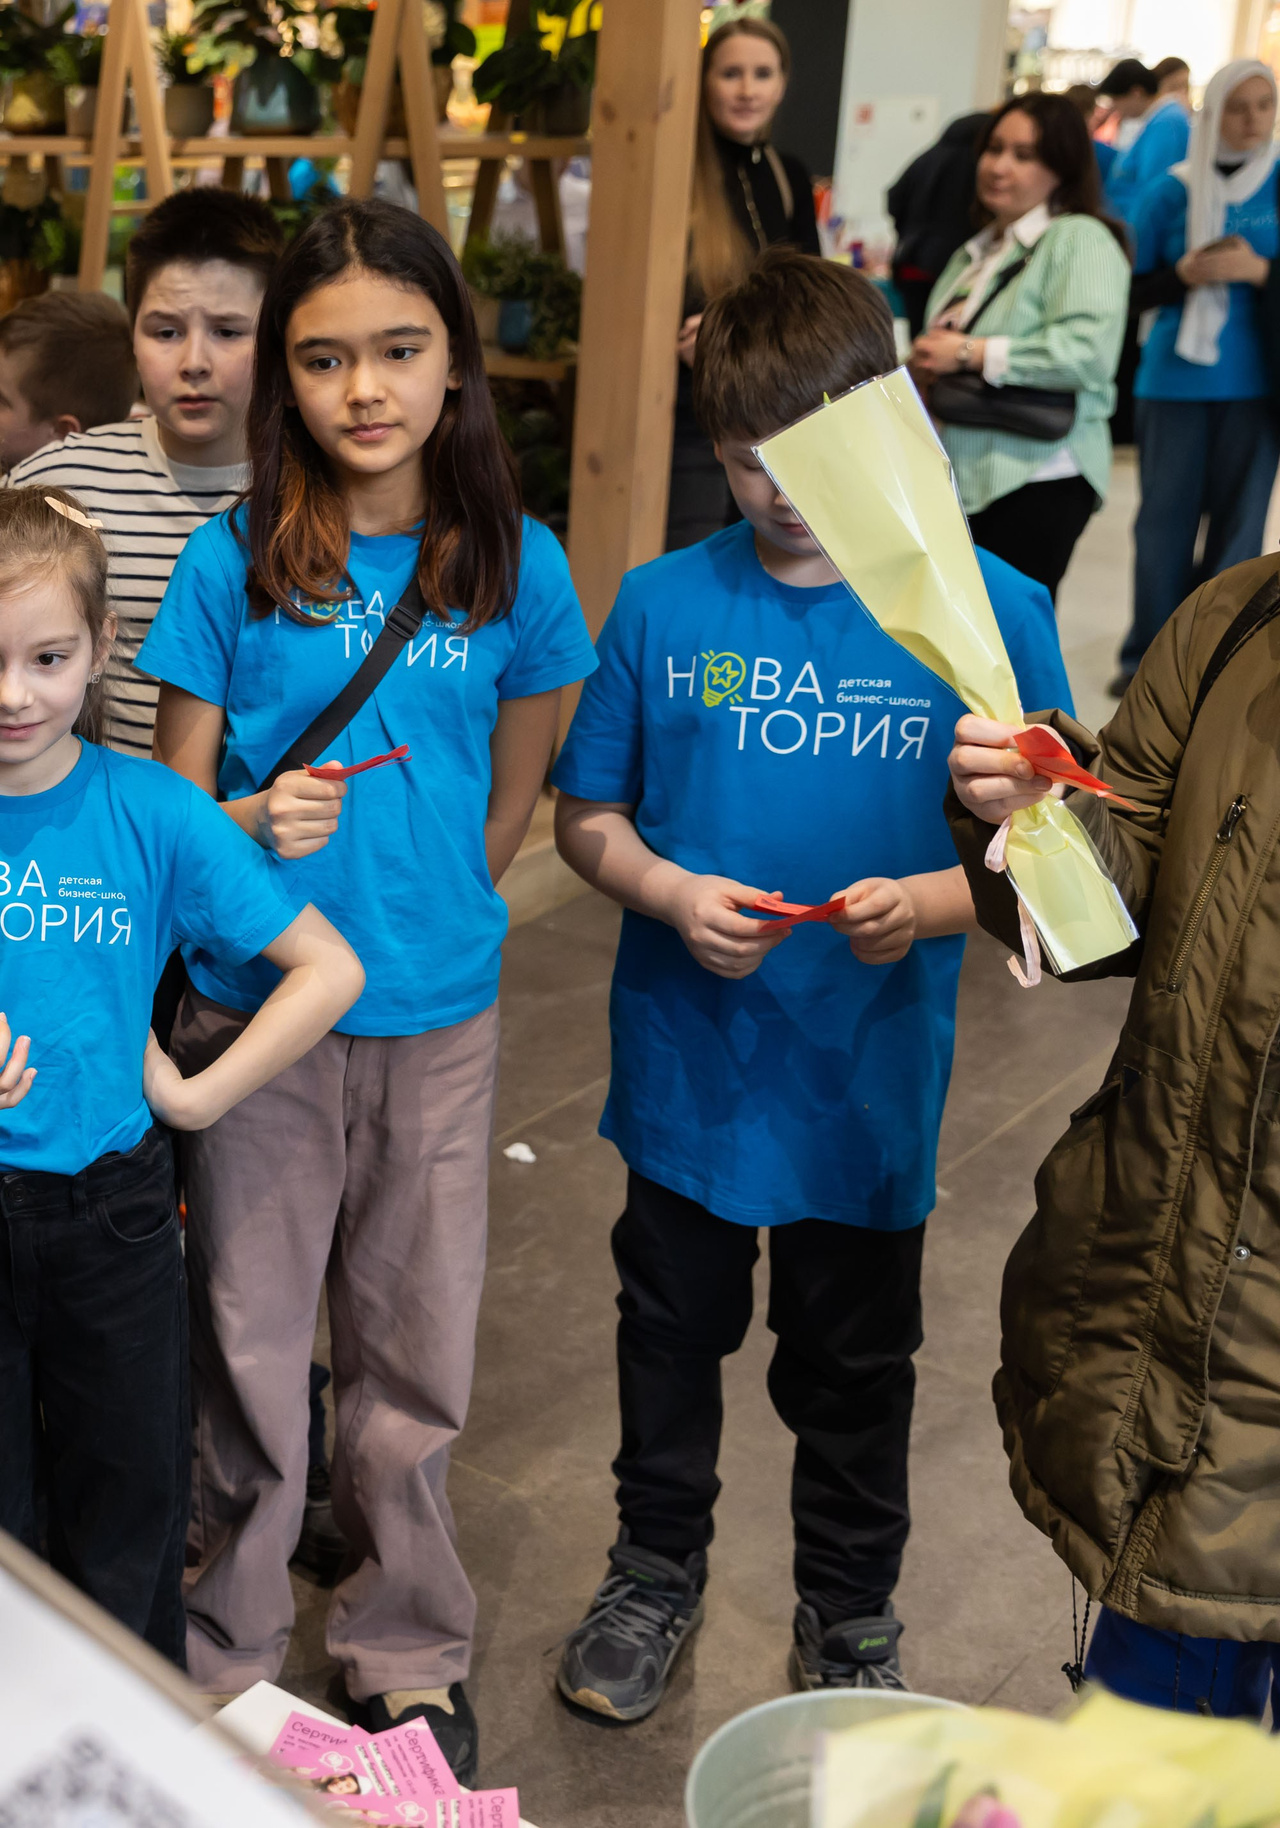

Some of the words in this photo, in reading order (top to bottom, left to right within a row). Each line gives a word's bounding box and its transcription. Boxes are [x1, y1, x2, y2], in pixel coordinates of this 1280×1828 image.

[837, 678, 892, 690] детская
[836, 691, 932, 709] бизнес-школа
[729, 705, 930, 760] ТОРИЯ
[58, 876, 103, 886] детская
[291, 1721, 348, 1745] Серти
